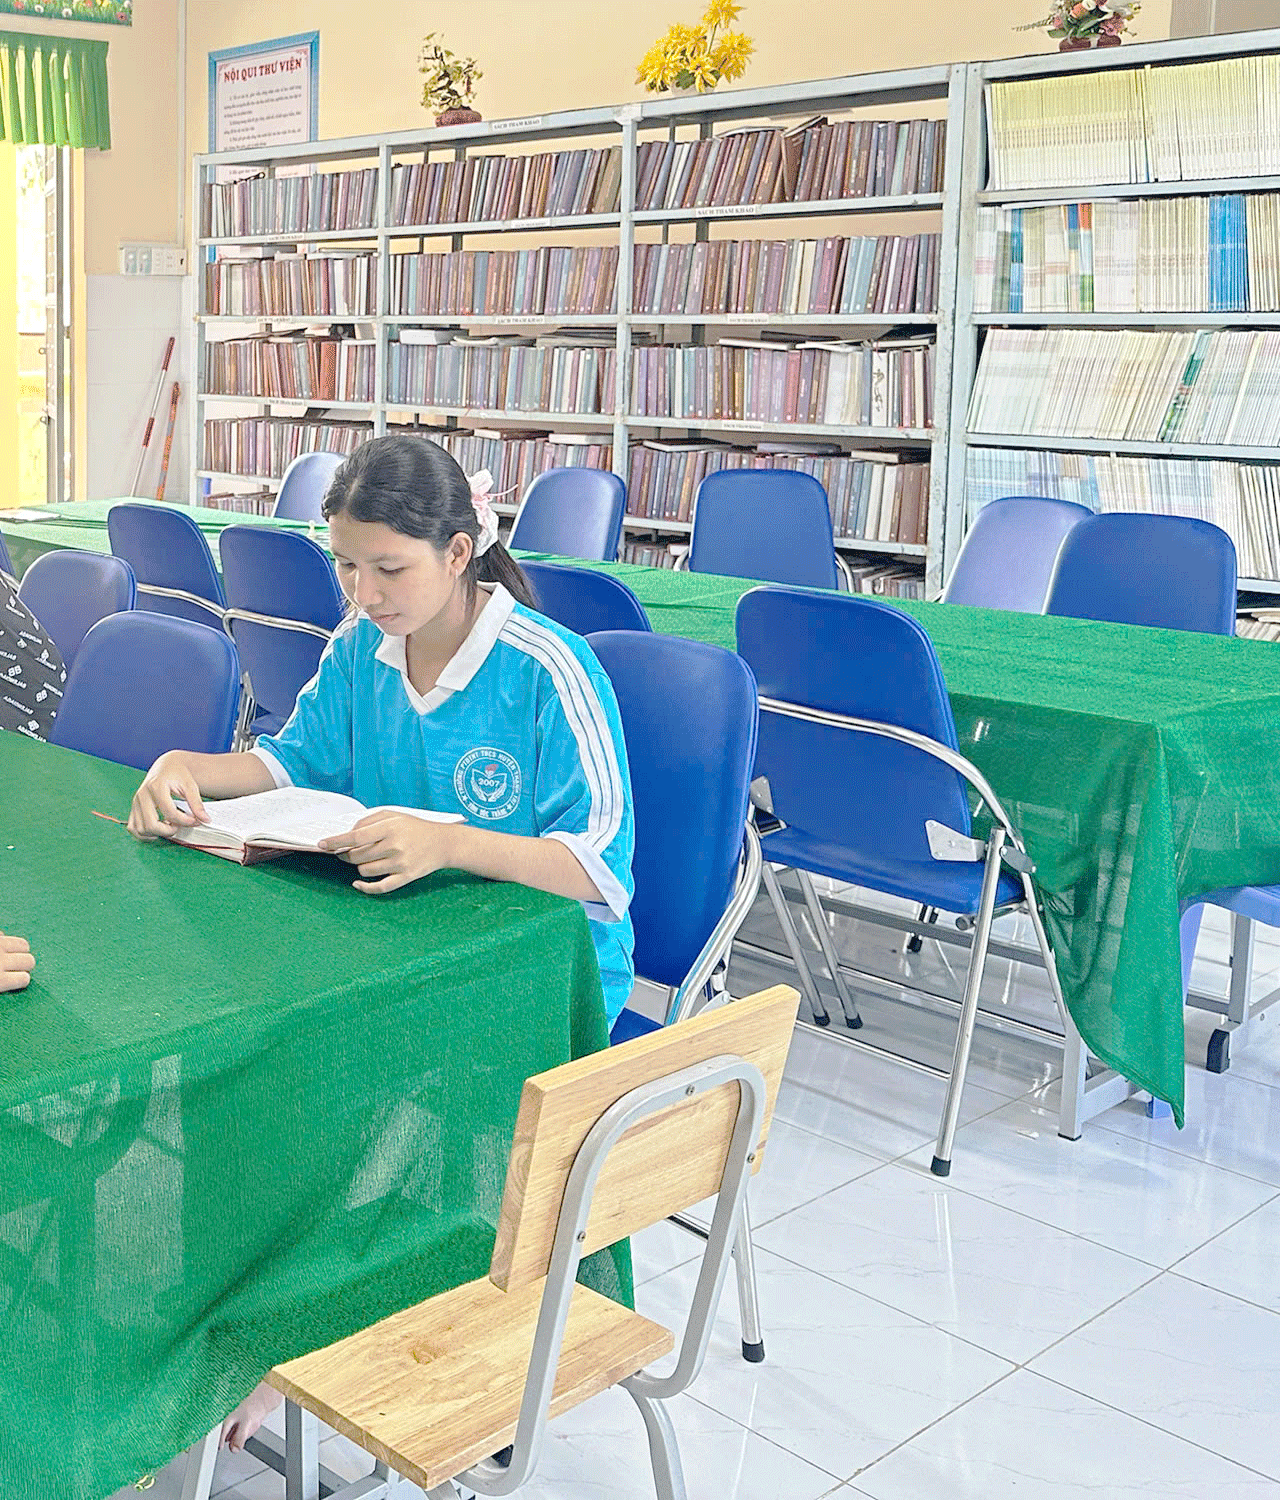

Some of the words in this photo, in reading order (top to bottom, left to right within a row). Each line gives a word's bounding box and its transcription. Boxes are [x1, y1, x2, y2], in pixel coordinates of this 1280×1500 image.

[241, 66, 257, 82] QUI
[279, 56, 303, 74] VIỆN
[478, 777, 500, 788] 2007
